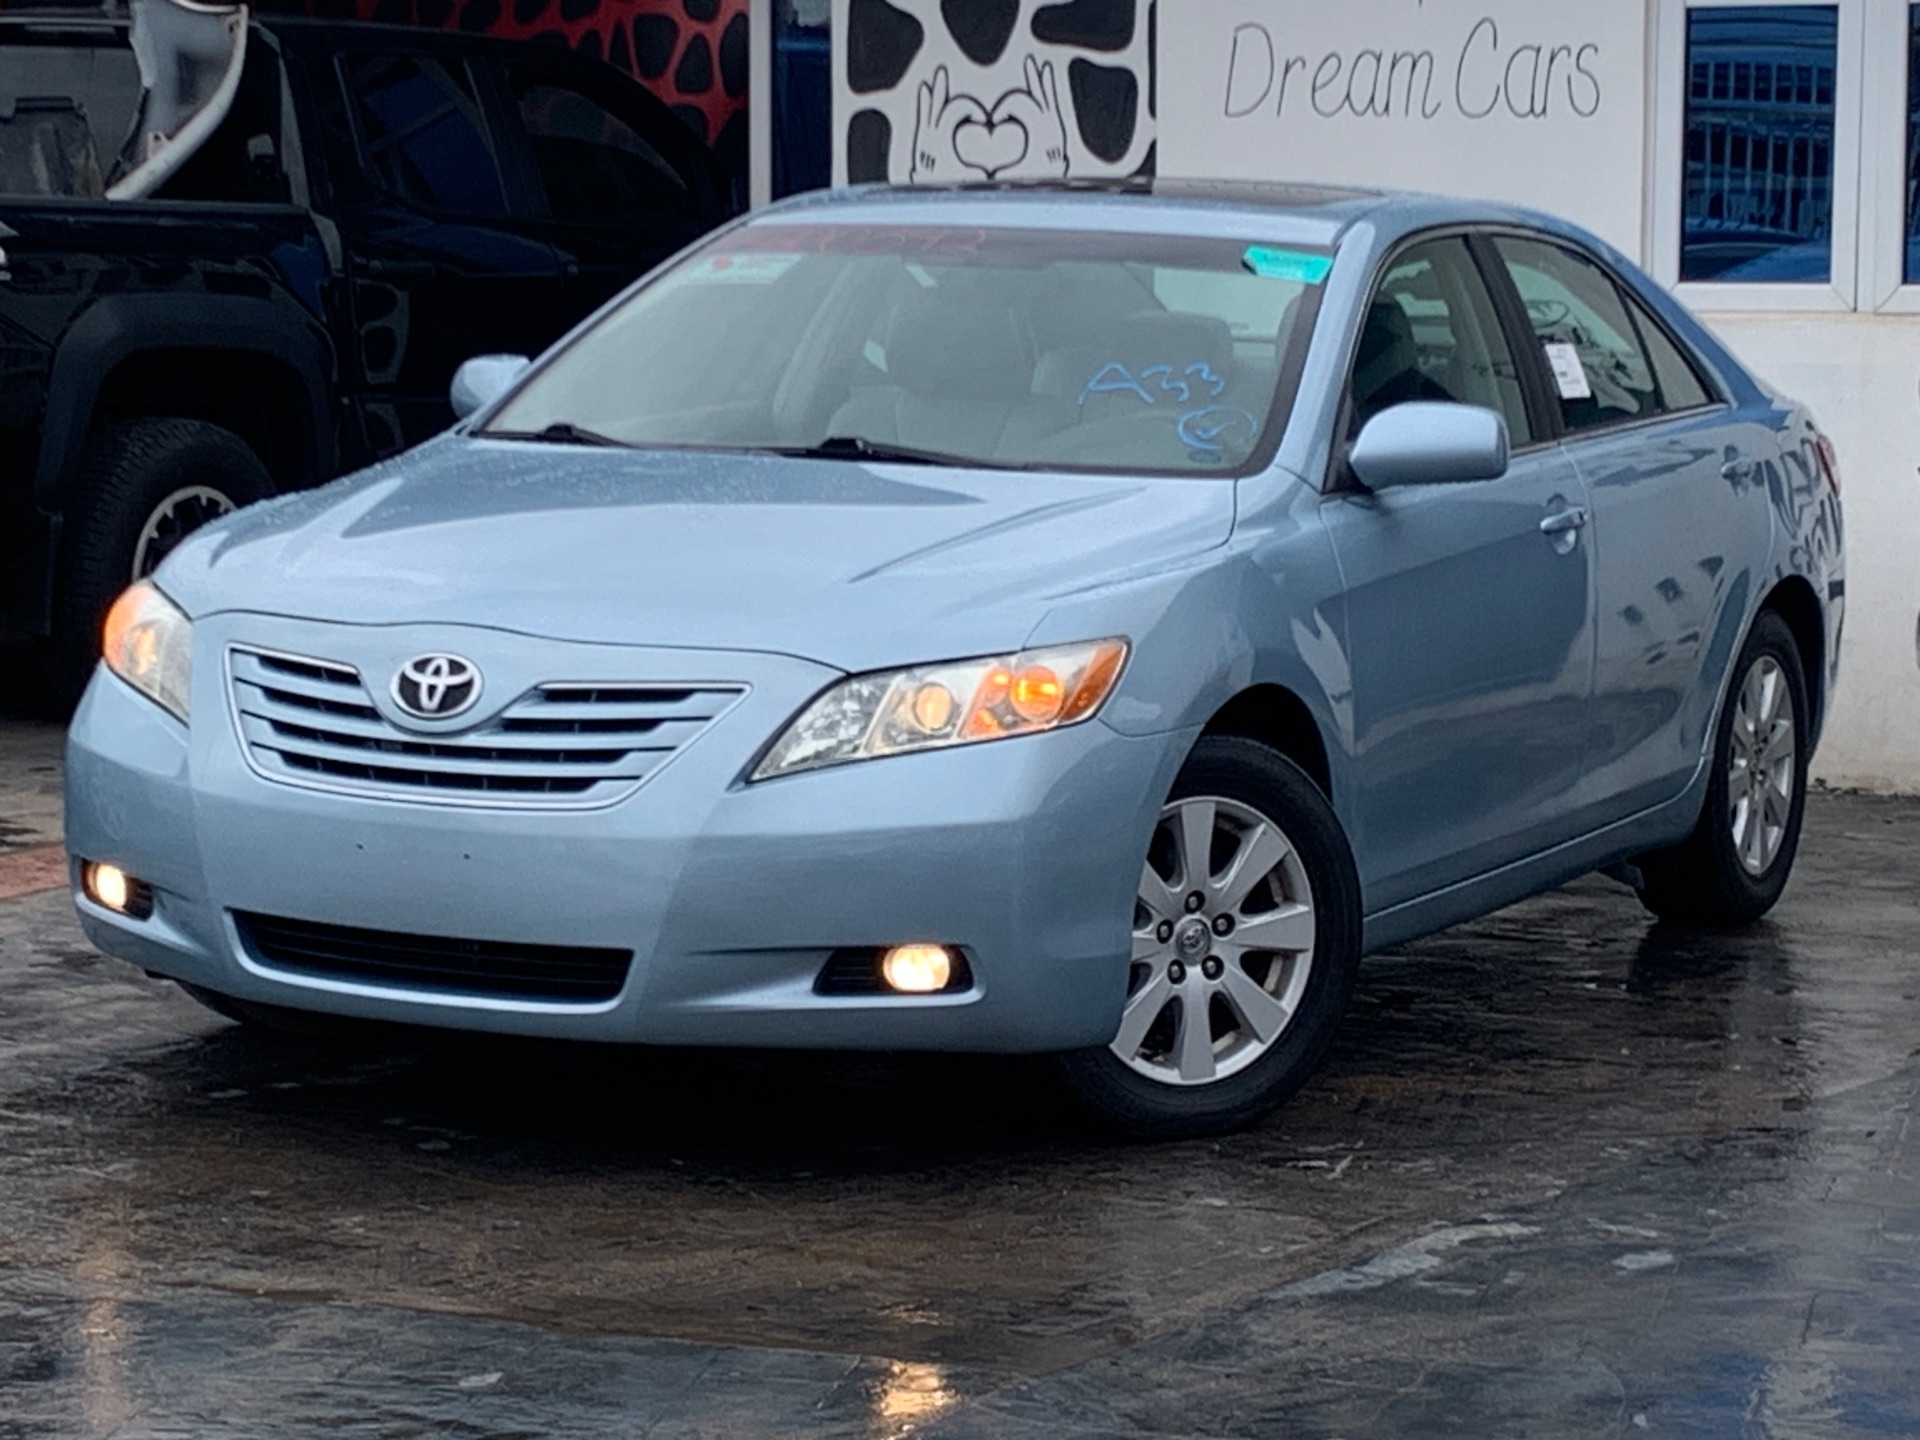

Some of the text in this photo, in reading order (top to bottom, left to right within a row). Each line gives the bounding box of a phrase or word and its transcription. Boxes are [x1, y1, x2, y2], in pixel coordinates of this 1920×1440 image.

[1224, 17, 1600, 119] Dream Cars
[1077, 361, 1225, 405] A33
